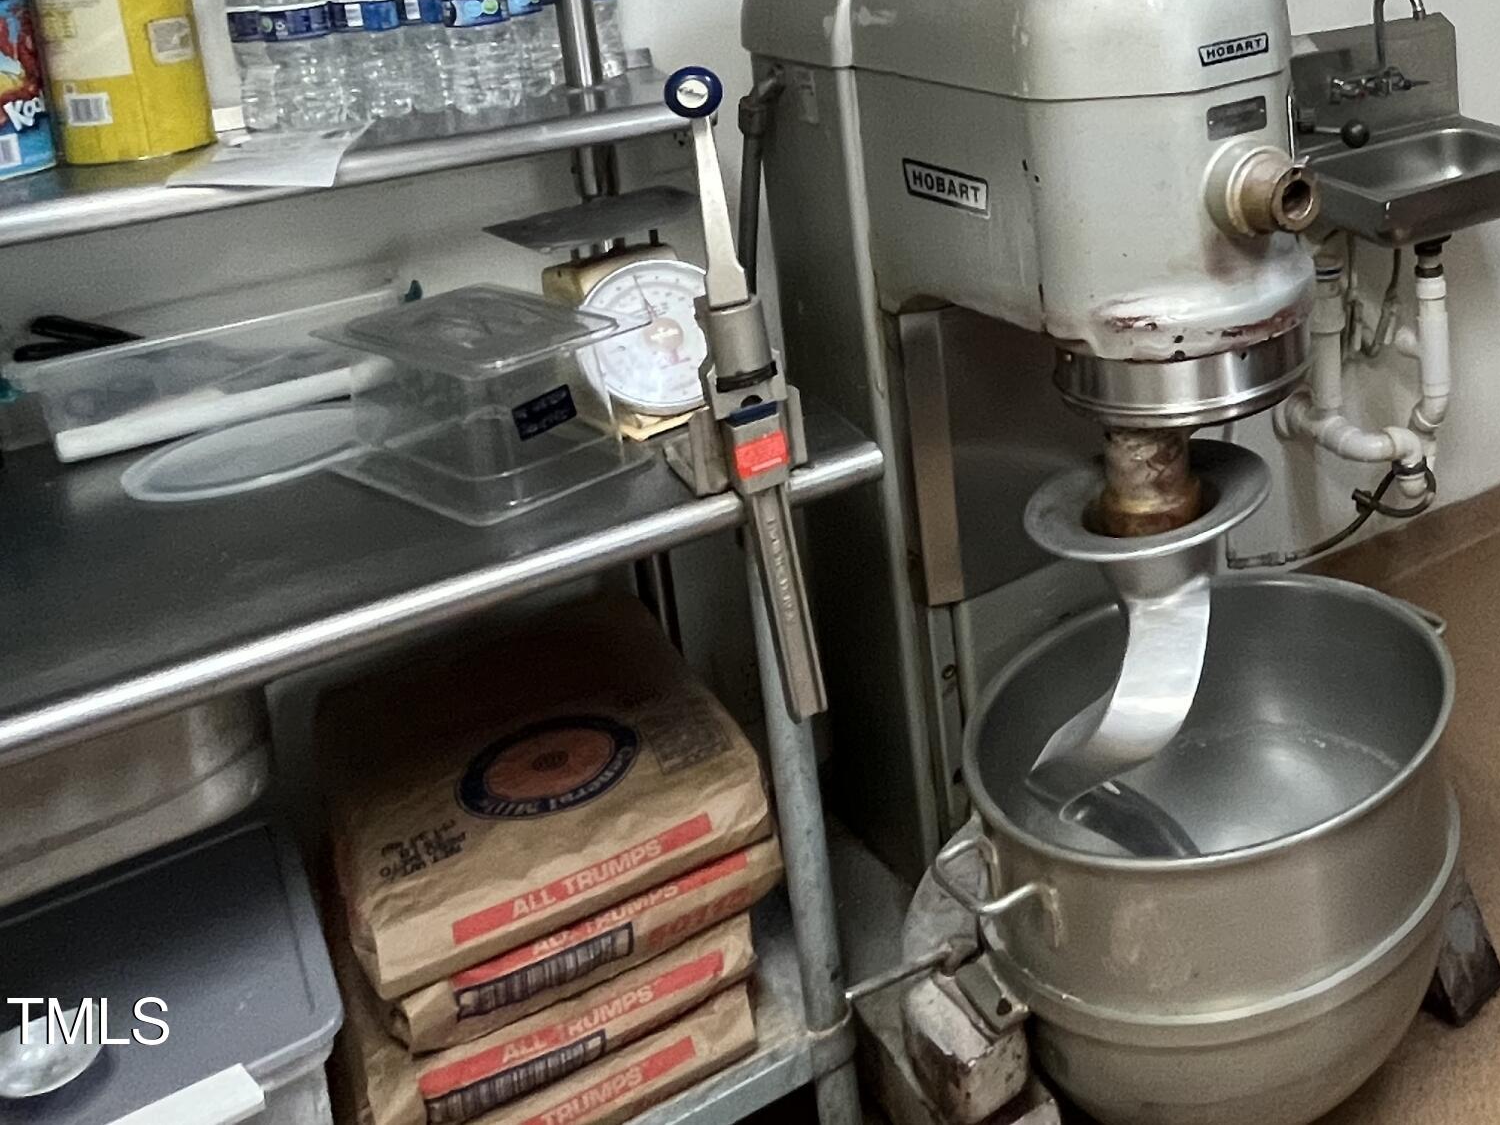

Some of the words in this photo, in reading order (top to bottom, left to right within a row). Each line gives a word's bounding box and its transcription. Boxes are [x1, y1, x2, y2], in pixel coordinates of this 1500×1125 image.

[1205, 37, 1264, 60] HOBART
[912, 170, 981, 205] HOBART
[512, 889, 556, 920] ALL
[563, 839, 663, 895] TRUMPS
[502, 1036, 548, 1063] ALL
[540, 1065, 643, 1125] TRUMPS
